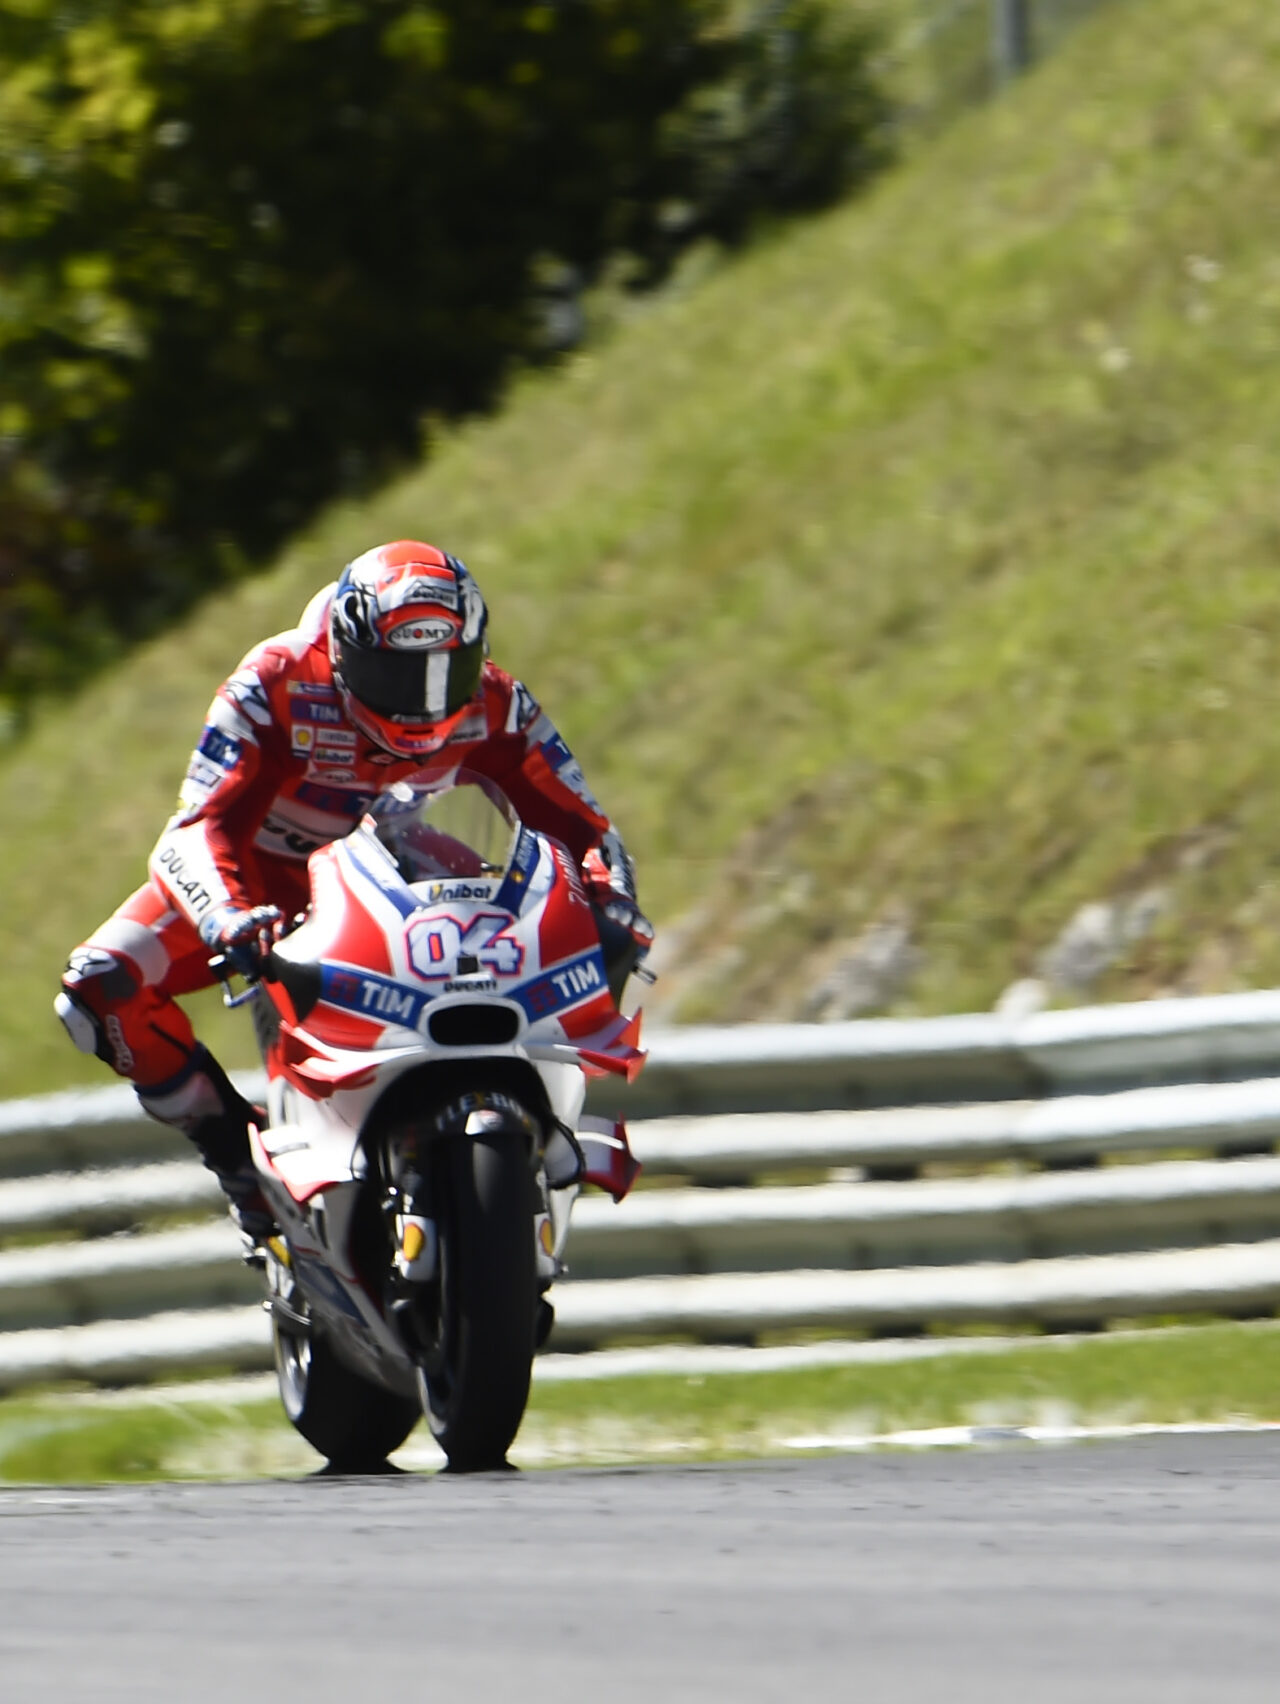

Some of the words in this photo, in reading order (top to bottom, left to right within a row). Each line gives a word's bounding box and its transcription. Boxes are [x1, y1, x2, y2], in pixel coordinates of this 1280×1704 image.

[309, 703, 341, 723] TIM
[160, 847, 211, 913] DUCATI
[429, 884, 492, 903] Unibat
[405, 913, 526, 982] 04
[443, 979, 498, 993] DUCATI
[552, 959, 600, 999] TIM
[361, 980, 415, 1020] TIM
